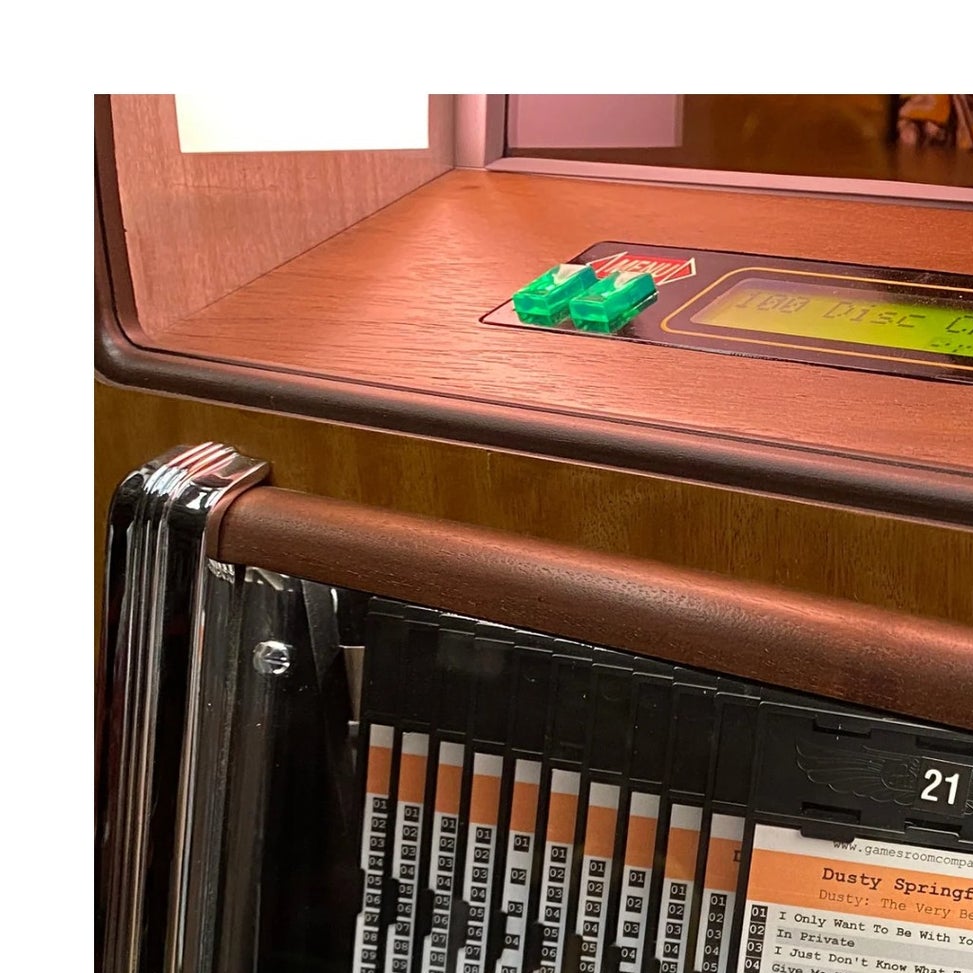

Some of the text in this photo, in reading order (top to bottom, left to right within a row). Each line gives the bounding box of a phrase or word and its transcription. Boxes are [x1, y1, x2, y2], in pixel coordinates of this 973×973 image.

[735, 290, 810, 313] 100
[823, 299, 926, 328] Disc
[921, 769, 959, 805] 21
[373, 798, 388, 810] 01
[404, 806, 419, 818] 01
[442, 817, 457, 829] 01
[476, 828, 491, 840] 01
[514, 836, 529, 848] 01
[551, 847, 566, 859] 01
[590, 861, 605, 873] 01
[629, 871, 644, 883] 01
[822, 867, 883, 891] Dusty
[671, 884, 686, 896] 01
[711, 895, 726, 907] 01
[819, 889, 869, 907] Dusty:
[881, 898, 906, 911] The
[916, 903, 951, 919] Very
[779, 911, 787, 920] I
[794, 913, 827, 928] Only
[833, 918, 866, 932] Want
[873, 924, 889, 935] To
[895, 927, 912, 938] Be
[919, 930, 951, 943] With
[776, 928, 855, 948] In Private
[774, 946, 782, 955] I
[789, 948, 821, 961] Just
[828, 953, 868, 967] Don't
[875, 960, 908, 972] Know
